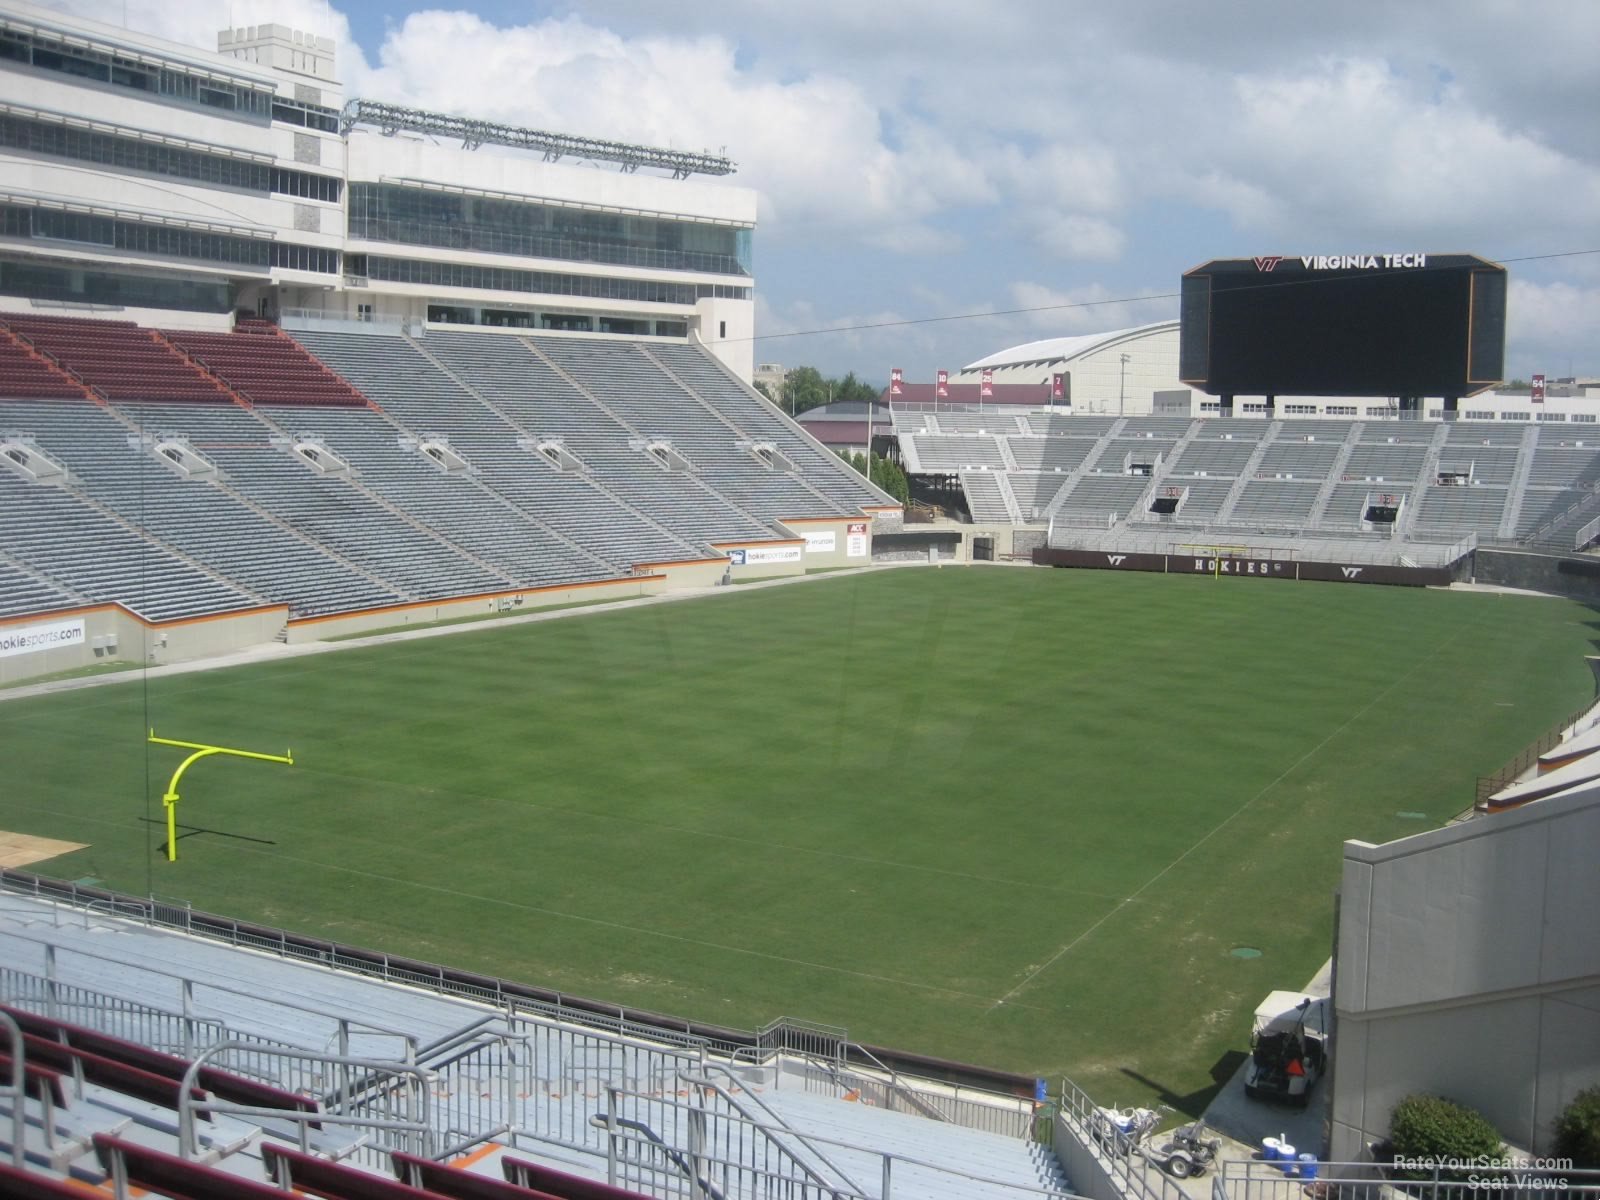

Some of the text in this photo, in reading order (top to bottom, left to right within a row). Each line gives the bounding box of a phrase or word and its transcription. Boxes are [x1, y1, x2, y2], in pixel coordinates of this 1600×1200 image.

[1300, 254, 1426, 270] VIRGINIA TECH
[938, 374, 947, 382] 10
[1195, 559, 1268, 574] HOKIES
